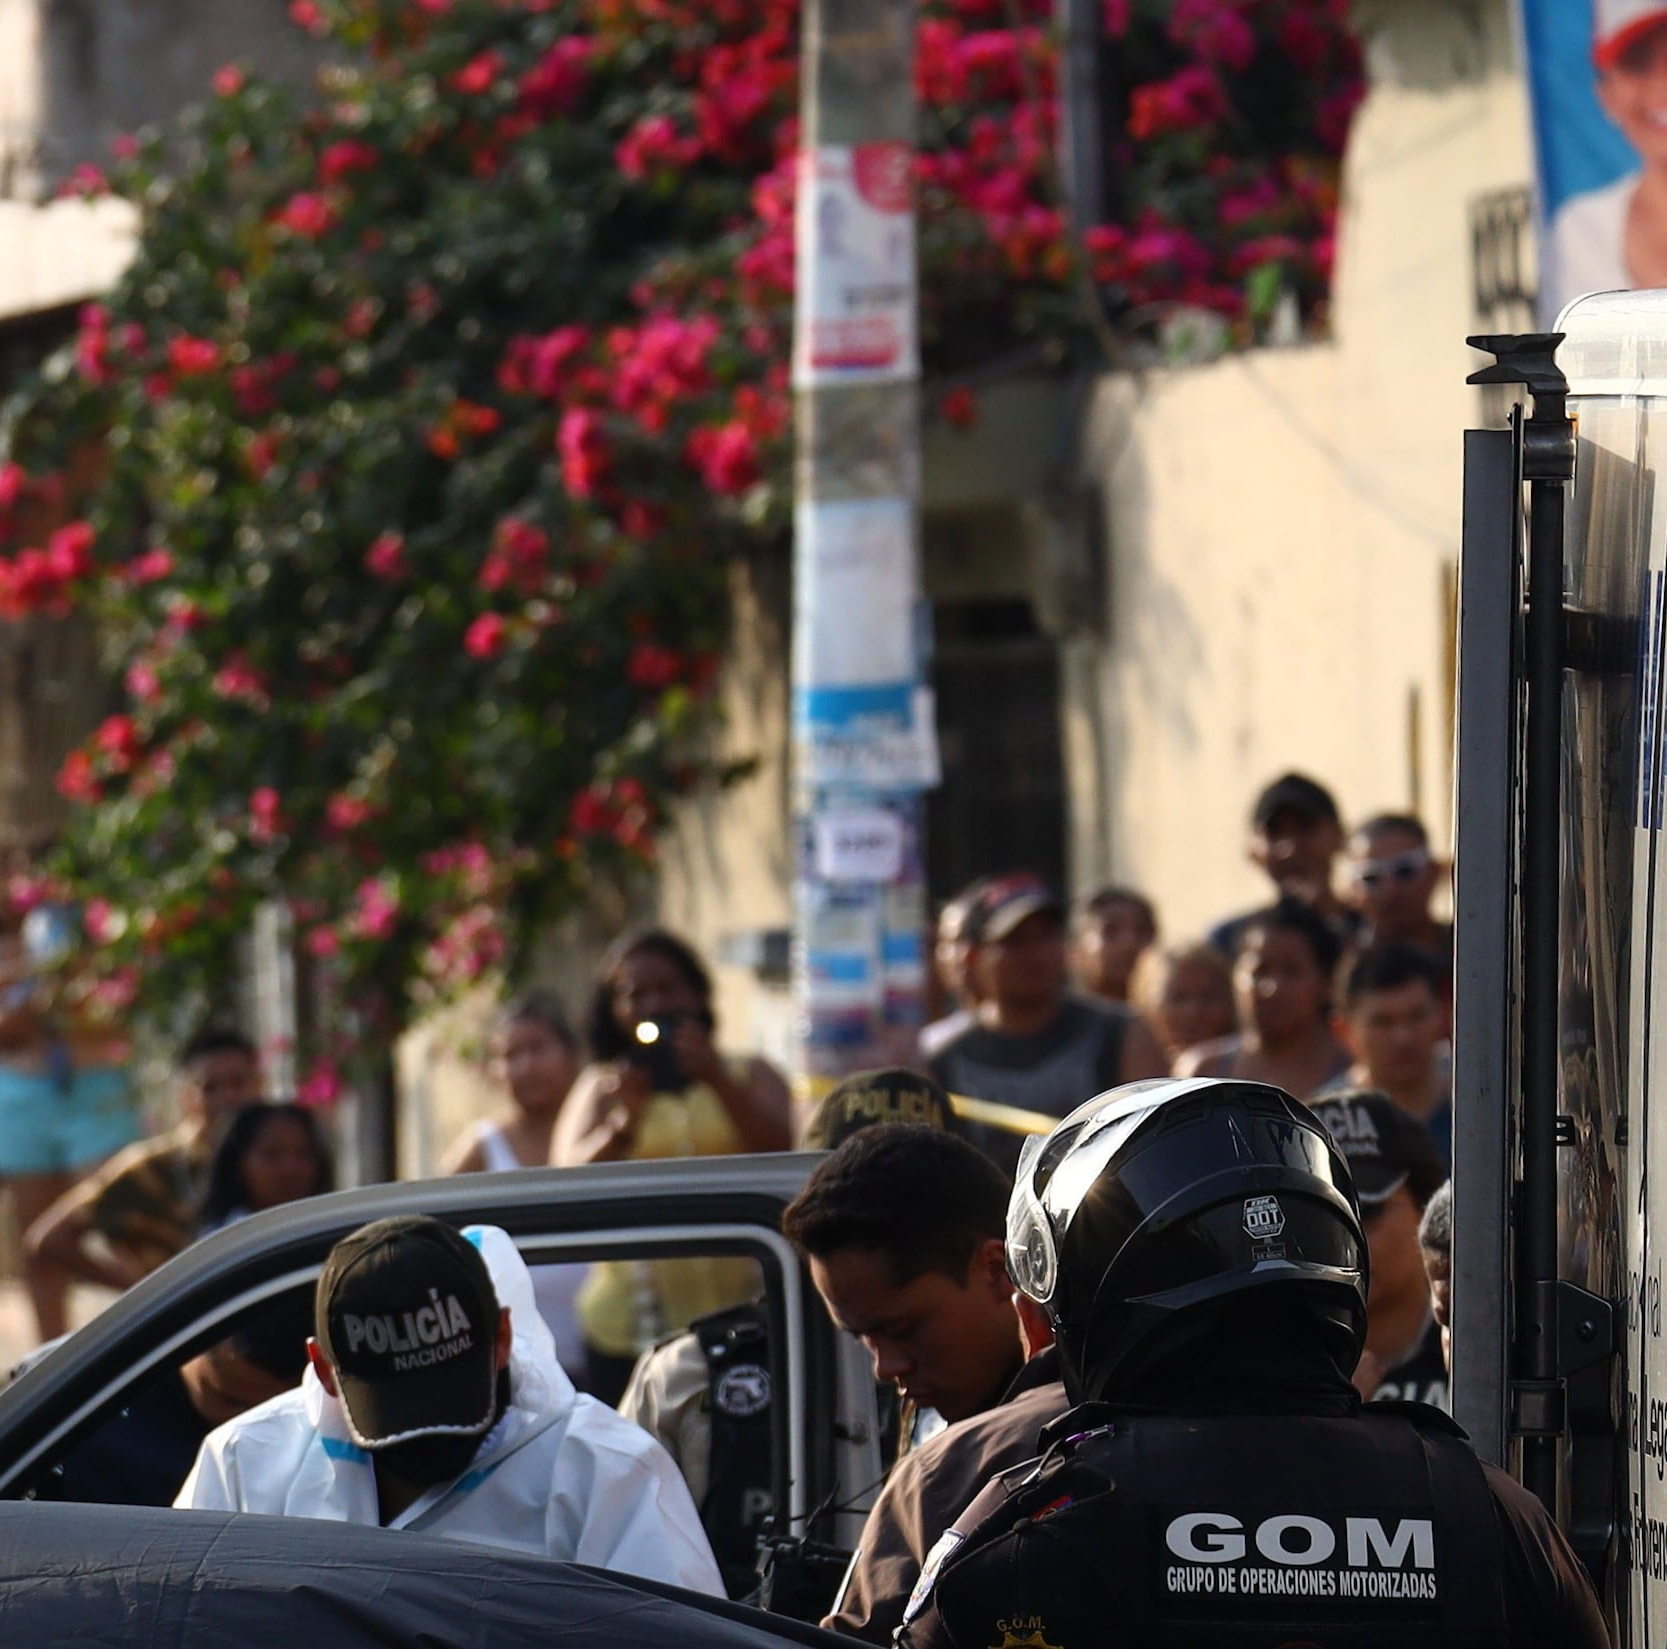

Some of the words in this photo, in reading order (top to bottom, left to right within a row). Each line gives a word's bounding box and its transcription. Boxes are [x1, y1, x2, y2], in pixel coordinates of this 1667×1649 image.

[344, 1287, 471, 1354] POLICÍA
[394, 1333, 473, 1370] NACIONAL
[1166, 1512, 1435, 1569] GOM
[1167, 1566, 1215, 1593] GRUPO
[1218, 1568, 1237, 1594] DE
[1240, 1568, 1336, 1596] OPERACIONES
[1339, 1572, 1437, 1600] MOTORIZADAS
